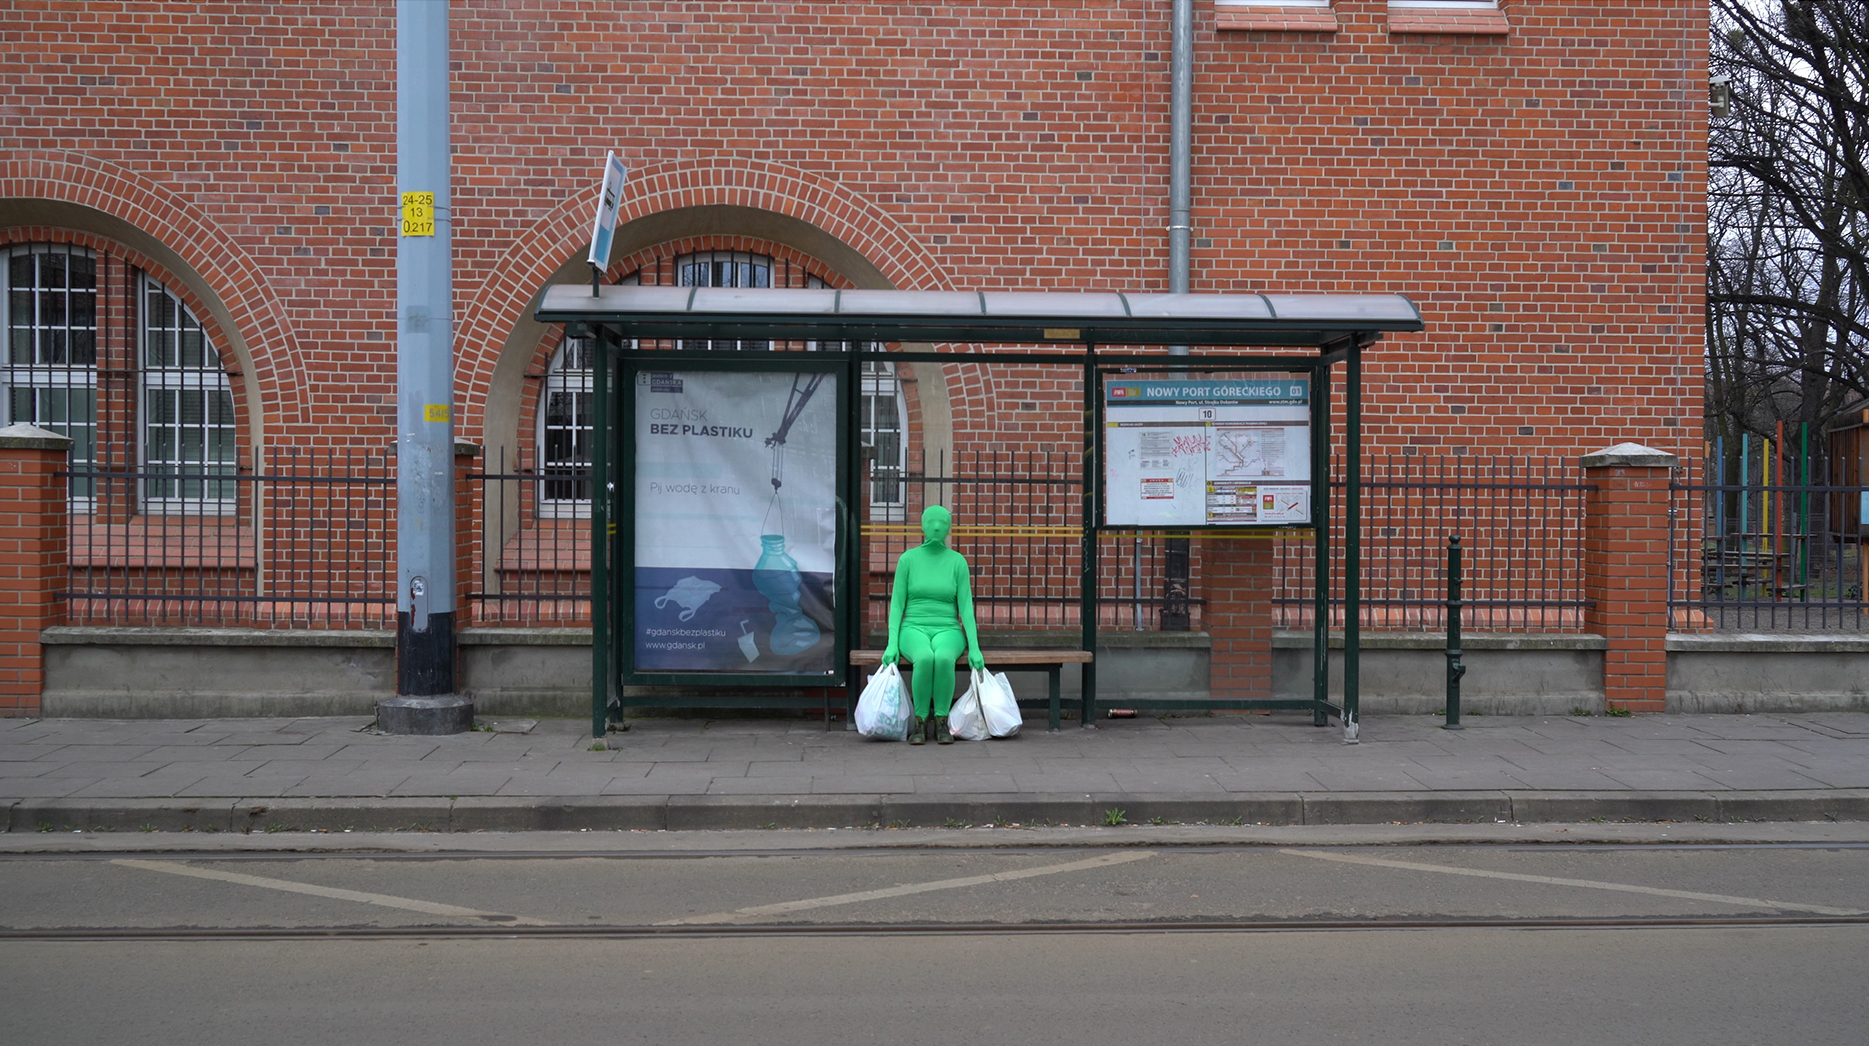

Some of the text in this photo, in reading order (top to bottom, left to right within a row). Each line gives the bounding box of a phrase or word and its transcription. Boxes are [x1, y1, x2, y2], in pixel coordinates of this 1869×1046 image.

[403, 194, 432, 205] 24-25
[410, 207, 423, 217] 13
[1147, 387, 1180, 397] NOWY
[1182, 387, 1211, 397] PORT
[1213, 385, 1282, 397] GÓRECKIEGO
[650, 407, 708, 421] GDAŃSK
[1203, 410, 1212, 418] 10
[650, 424, 753, 438] BEZ PLASTIKU
[650, 482, 740, 495] Pij wodę z kranu
[645, 628, 726, 637] #gdanskbezplastiku
[645, 642, 706, 650] www.gdansk.pl
